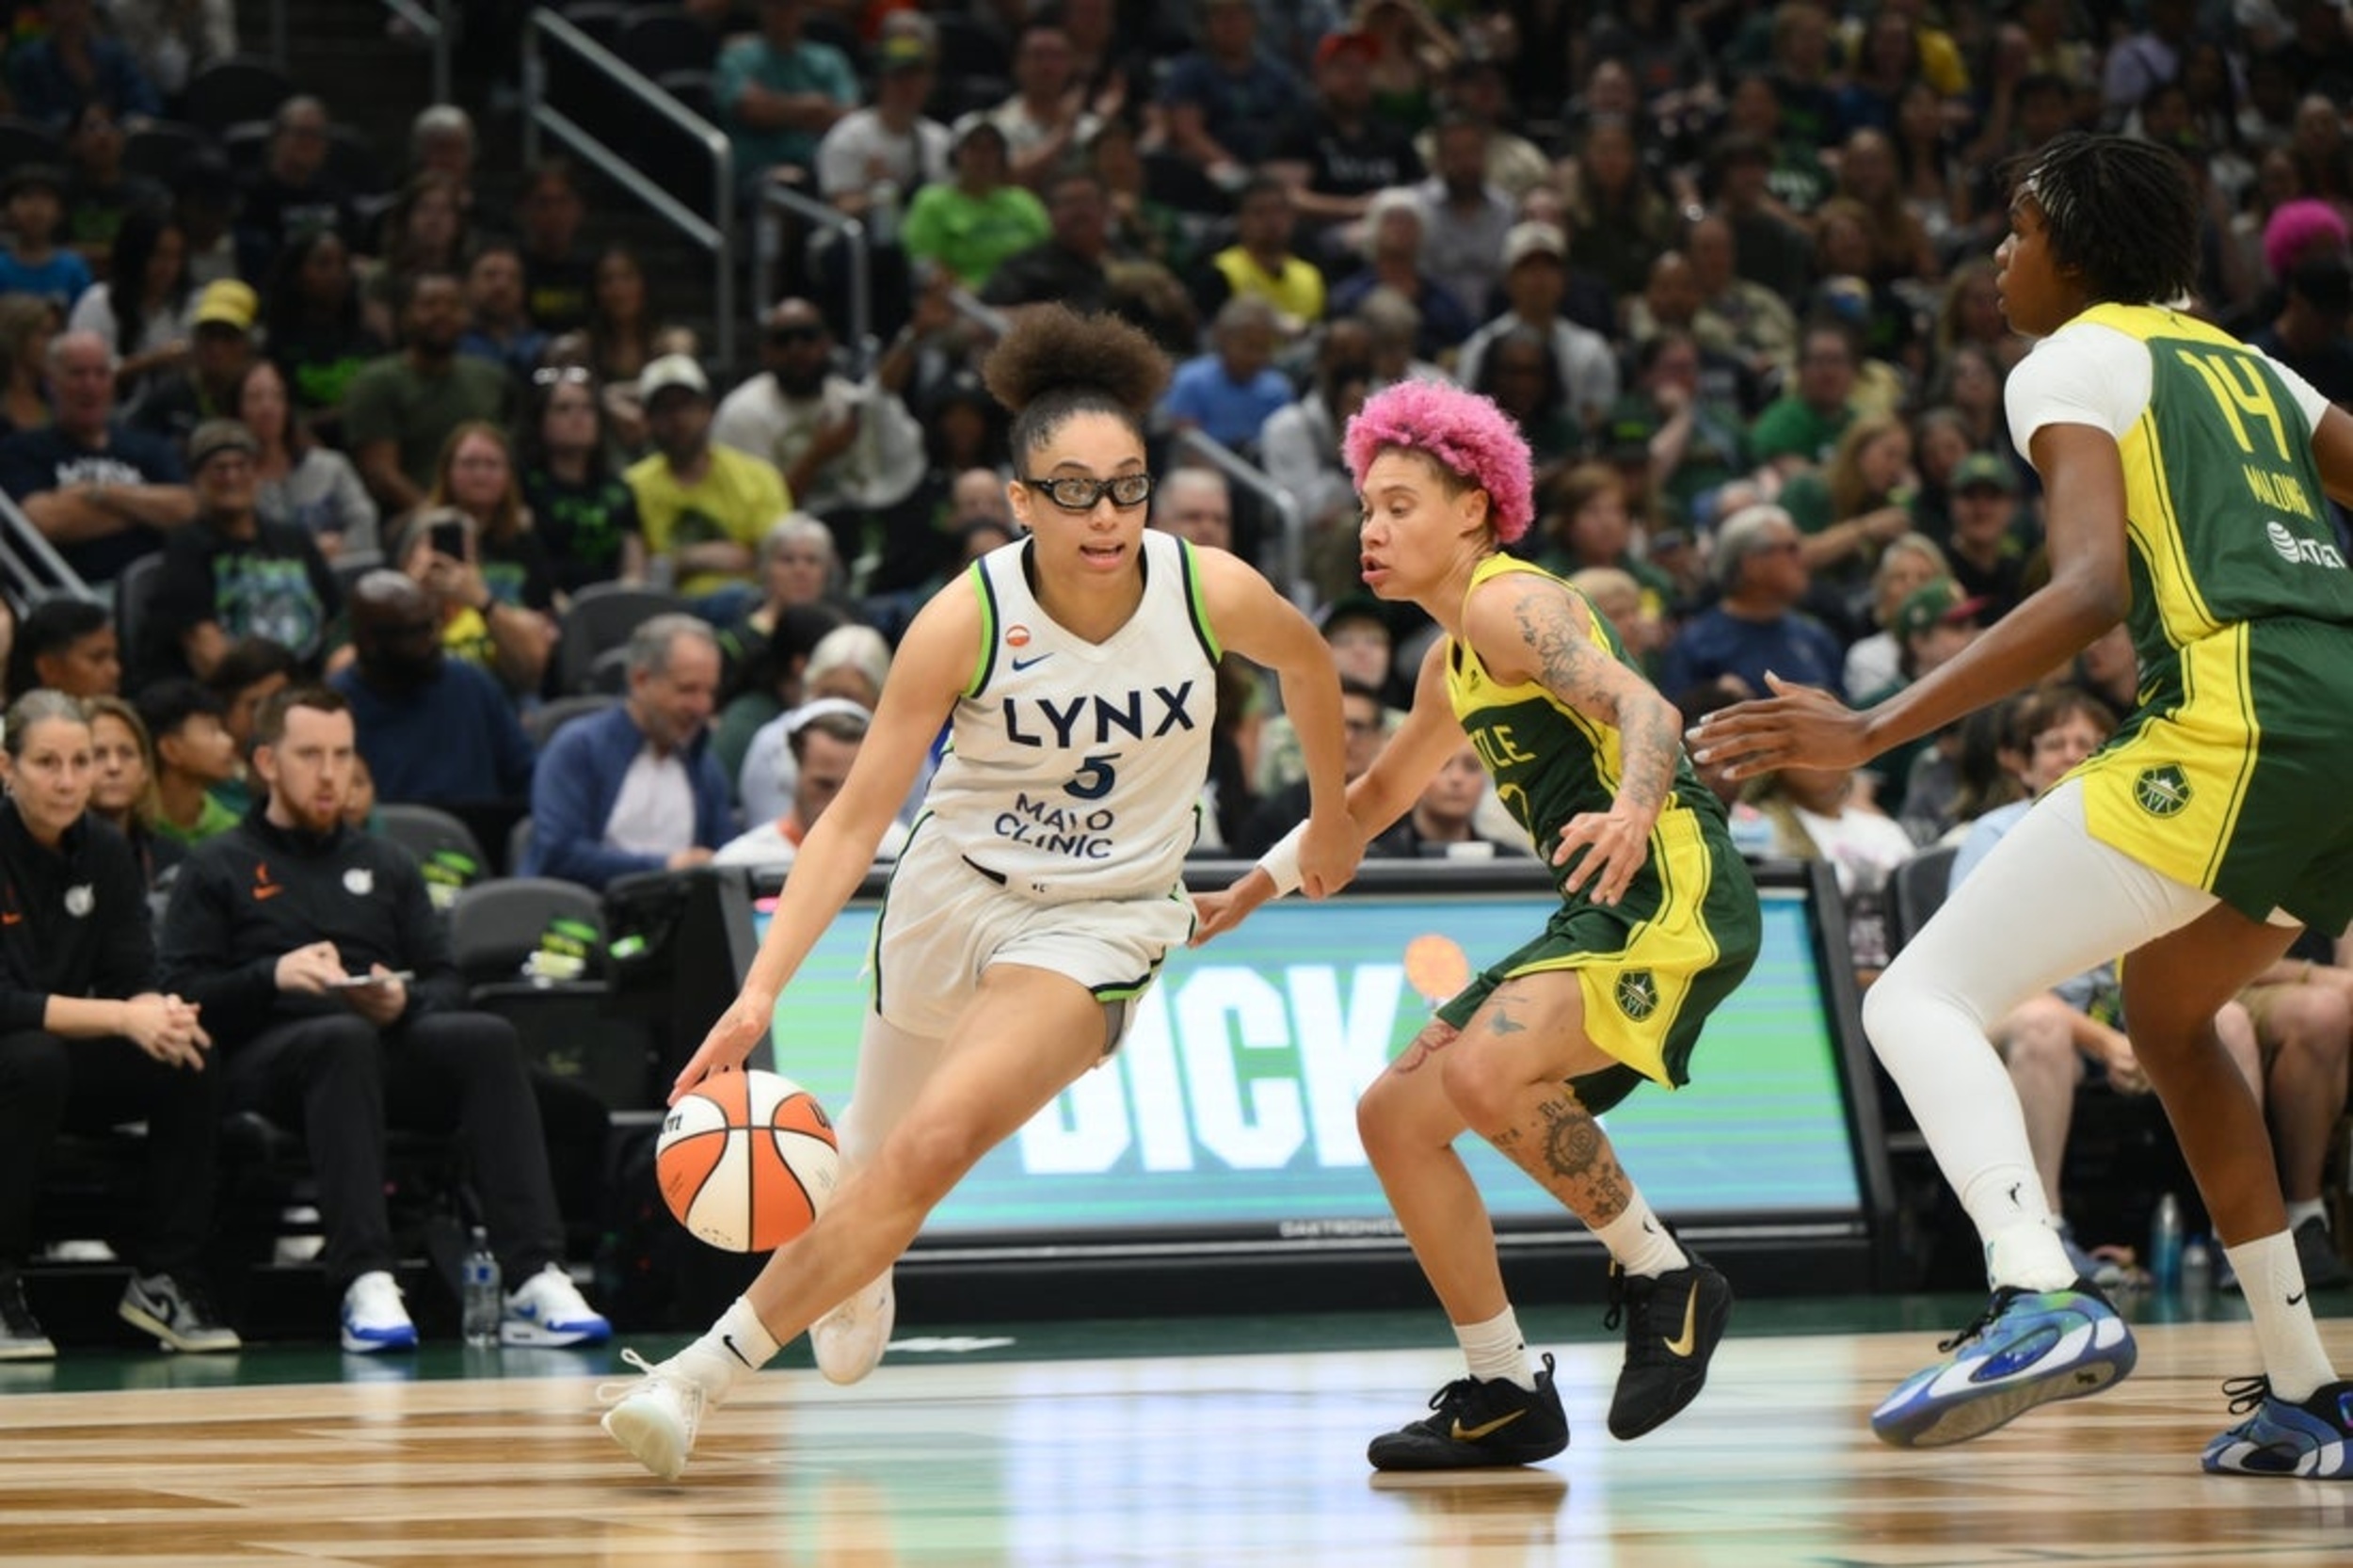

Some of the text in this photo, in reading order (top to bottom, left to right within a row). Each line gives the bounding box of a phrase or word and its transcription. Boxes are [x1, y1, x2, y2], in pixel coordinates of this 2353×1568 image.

[2175, 349, 2292, 462] 14
[1002, 680, 1195, 749] LYNX
[1062, 752, 1122, 800] 5
[994, 812, 1113, 859] CLINIC
